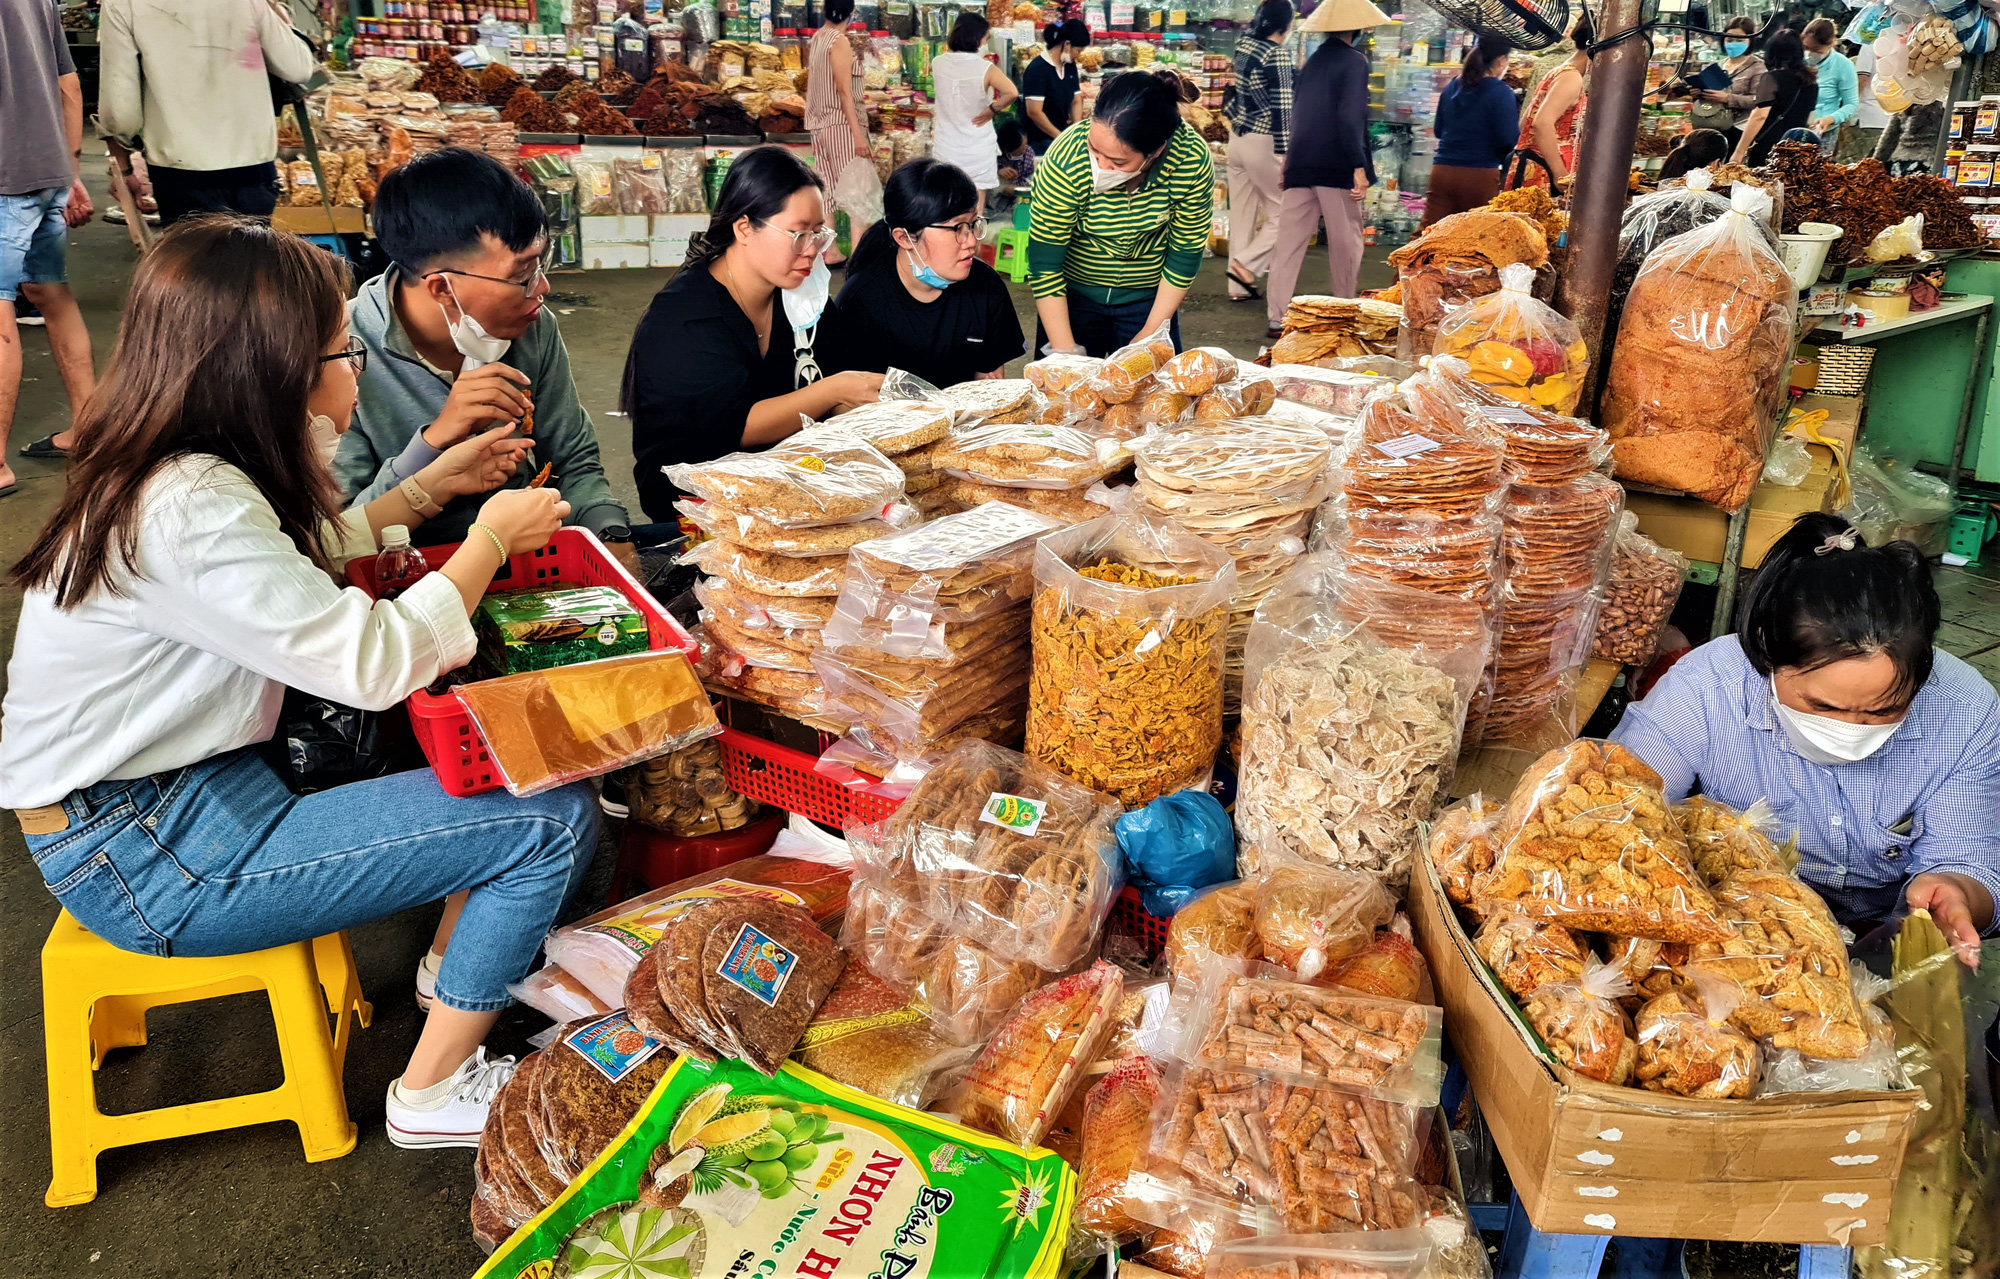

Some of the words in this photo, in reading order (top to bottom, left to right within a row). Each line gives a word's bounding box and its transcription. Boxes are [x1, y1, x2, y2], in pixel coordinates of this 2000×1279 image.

[579, 1026, 603, 1045] BÁNH
[815, 1147, 854, 1190] Sữa
[821, 1149, 904, 1247] NHƠN
[898, 1186, 954, 1246] Bánh
[770, 1203, 819, 1254] Nước
[794, 1247, 842, 1279] H
